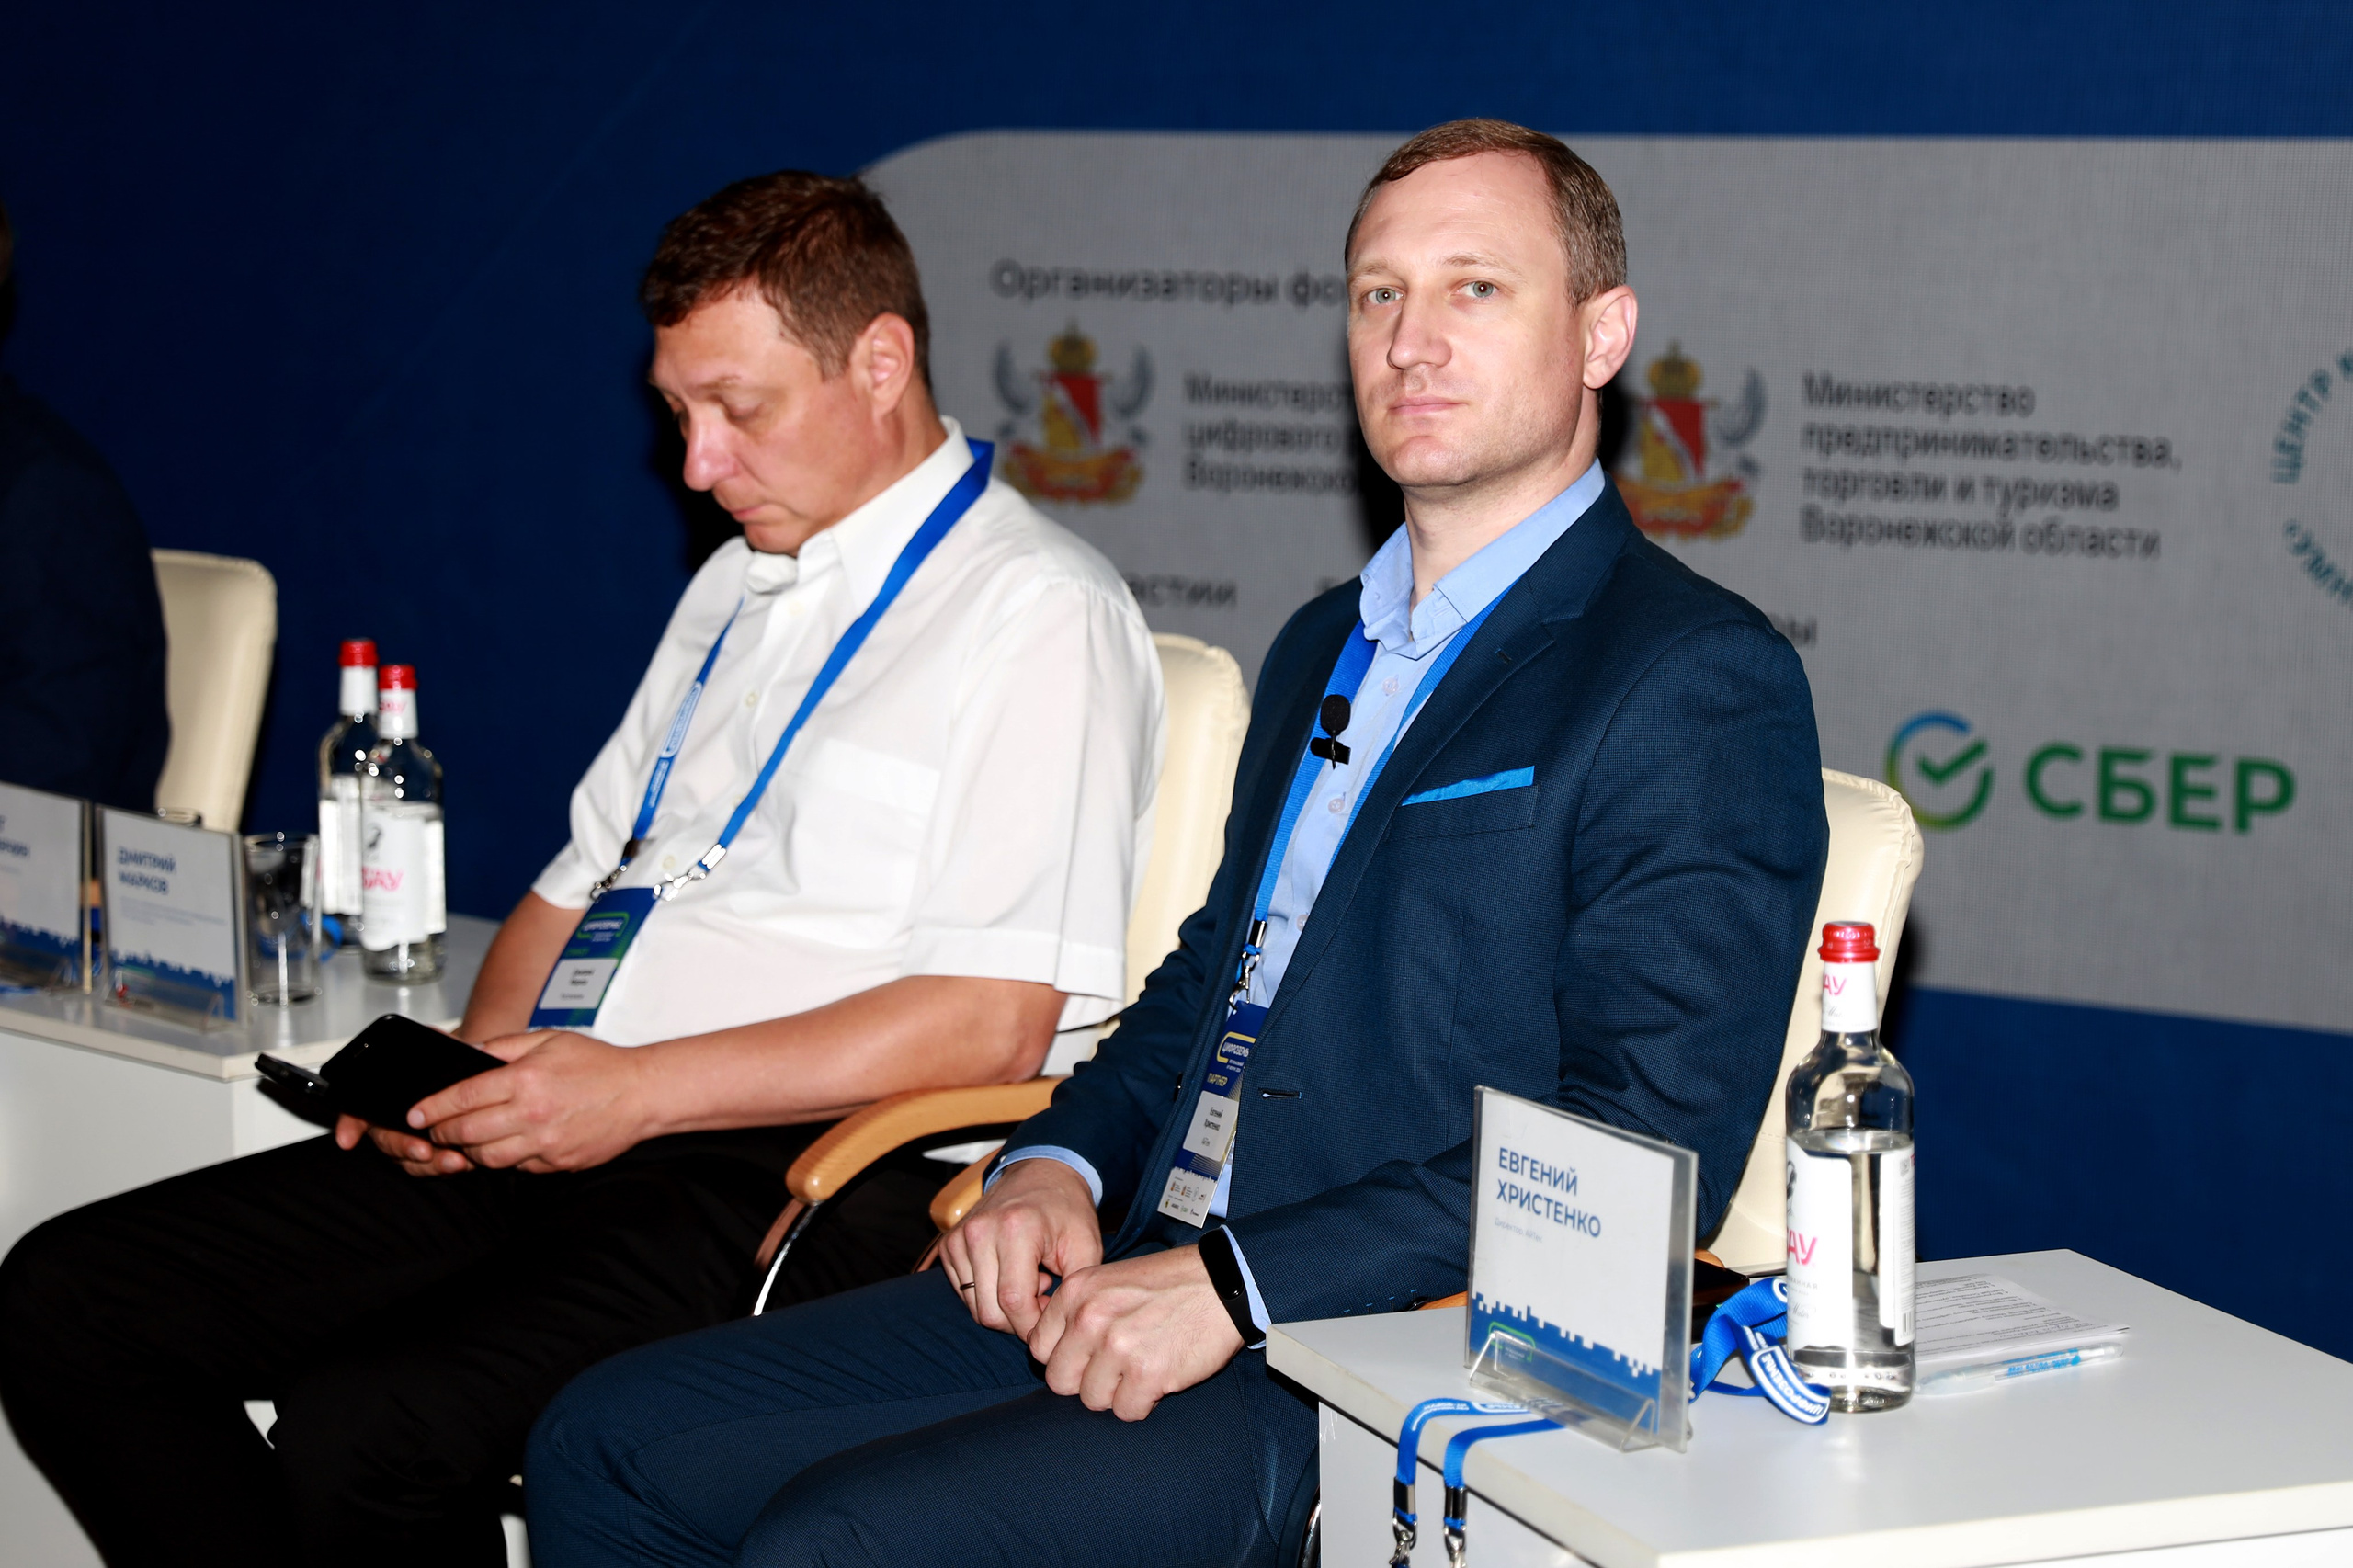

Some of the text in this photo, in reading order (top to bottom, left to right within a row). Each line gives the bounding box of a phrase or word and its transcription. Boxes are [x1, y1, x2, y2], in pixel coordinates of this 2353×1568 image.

[991, 259, 1278, 305] Организаторы
[1804, 371, 2035, 417] Министерство
[1804, 424, 2181, 472] предпринимательства,
[2270, 369, 2332, 484] ЦЕНТР
[1804, 468, 2120, 517] торговли и туризма
[1802, 505, 2161, 561] Воронежской области
[2026, 743, 2296, 833] СБЕР
[119, 846, 176, 872] ДМИТРИЙ
[119, 871, 169, 894] МАРКОВ
[1222, 1041, 1249, 1057] ЦИФРОЗЕМЬ
[1499, 1146, 1578, 1197] ЕВГЕНИЙ
[1496, 1178, 1601, 1238] ХРИСТЕНКО
[1761, 1352, 1825, 1415] ЦИФРОЗЕМЬЕ
